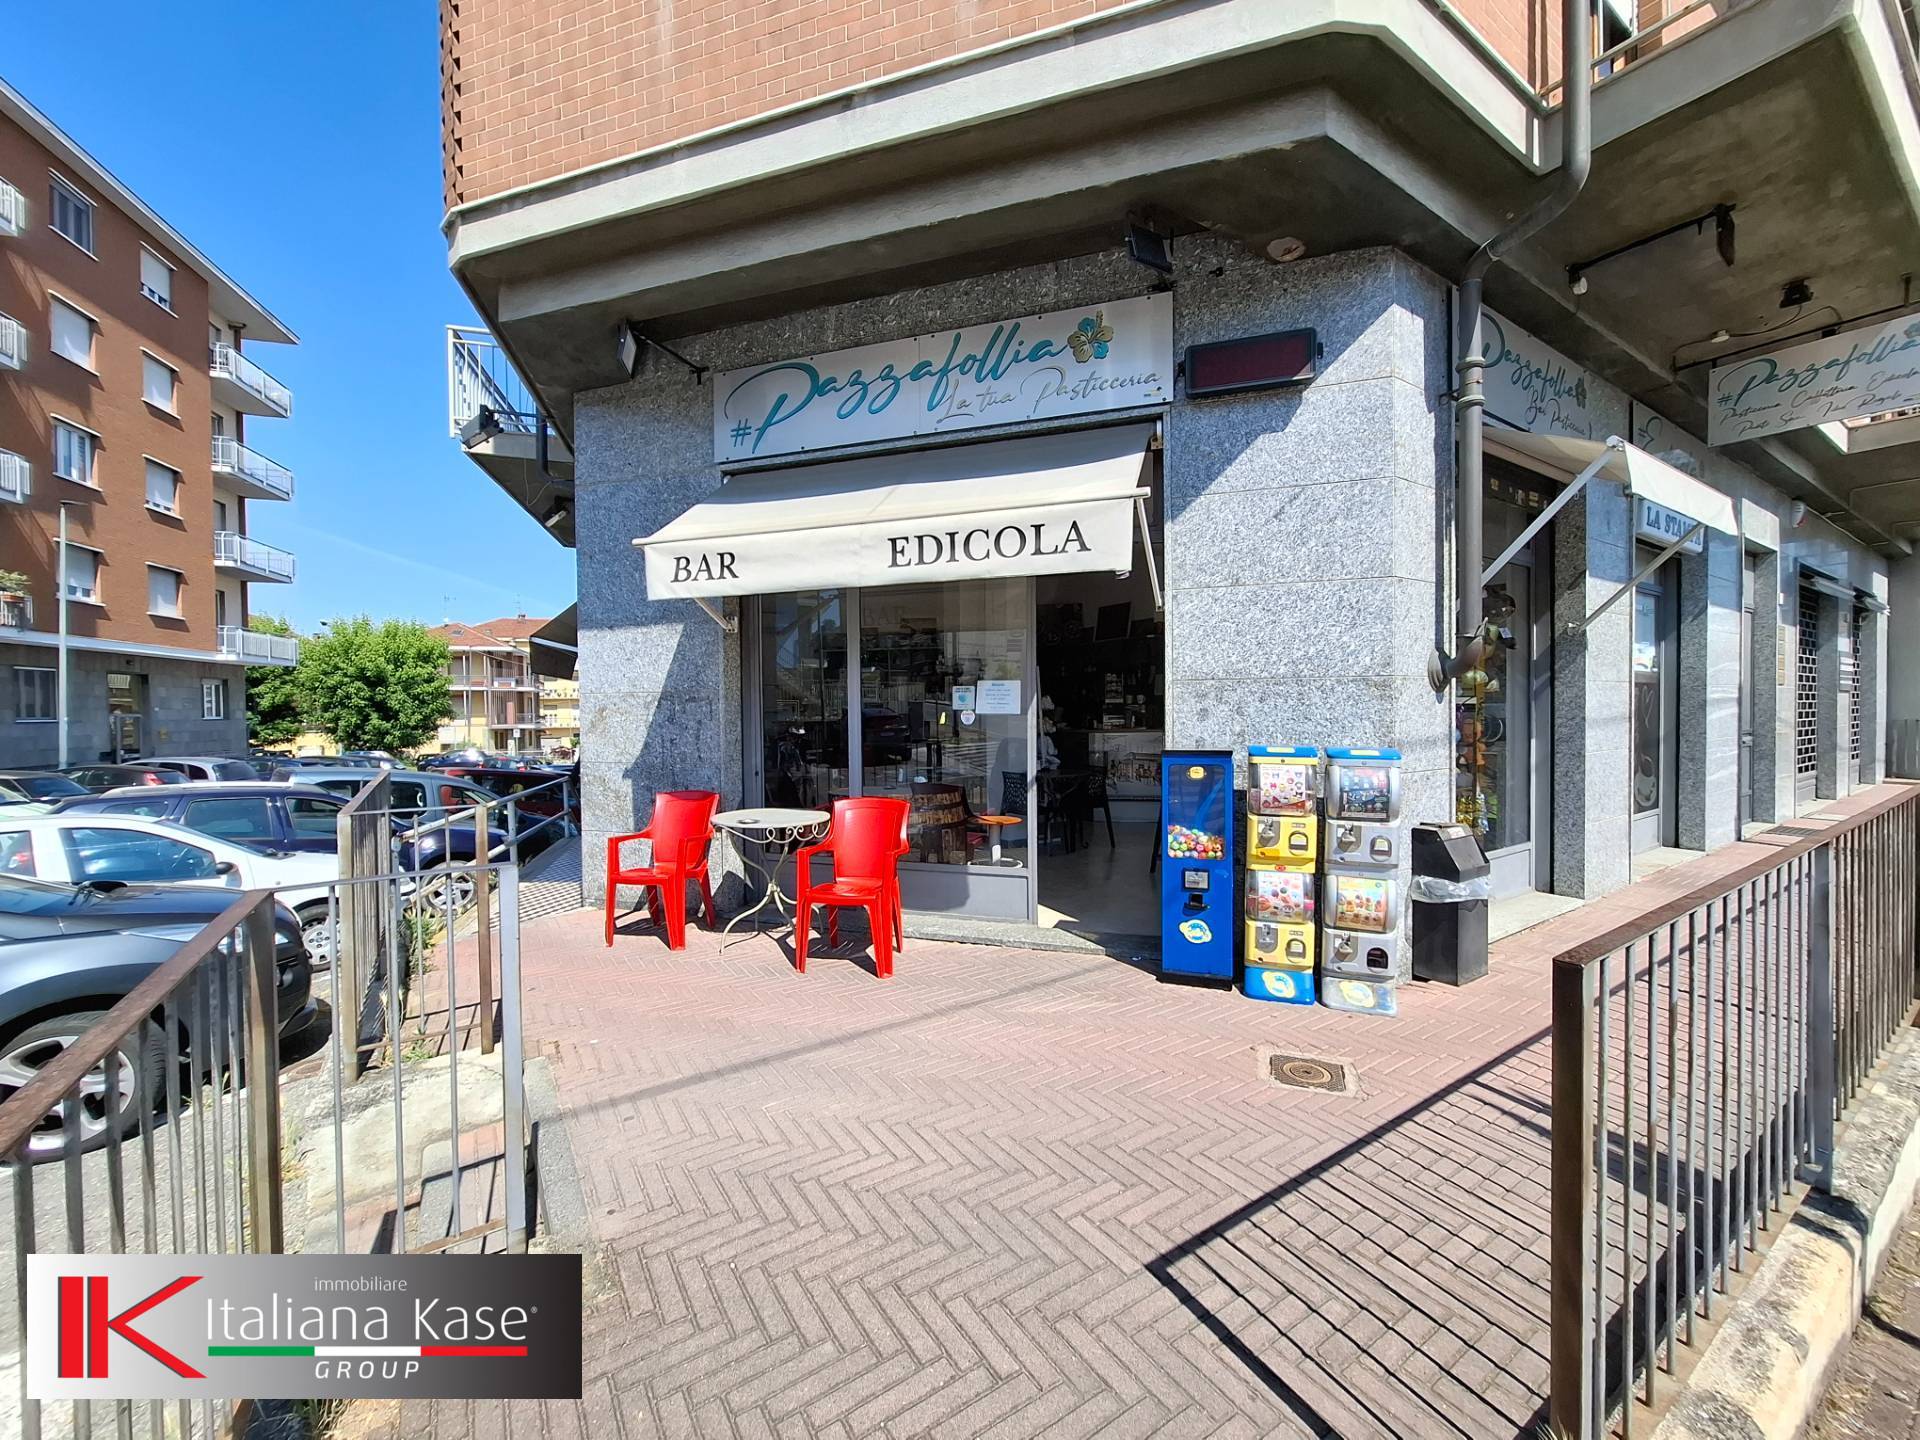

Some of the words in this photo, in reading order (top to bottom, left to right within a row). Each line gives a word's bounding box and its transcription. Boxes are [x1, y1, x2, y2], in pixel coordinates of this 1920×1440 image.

[935, 377, 974, 425] La
[976, 385, 1017, 412] tua
[1020, 367, 1162, 413] Pasticceria
[670, 551, 739, 584] BAR
[888, 519, 1092, 569] EDICOLA
[1646, 506, 1661, 530] LA
[1664, 513, 1702, 546] STAMA
